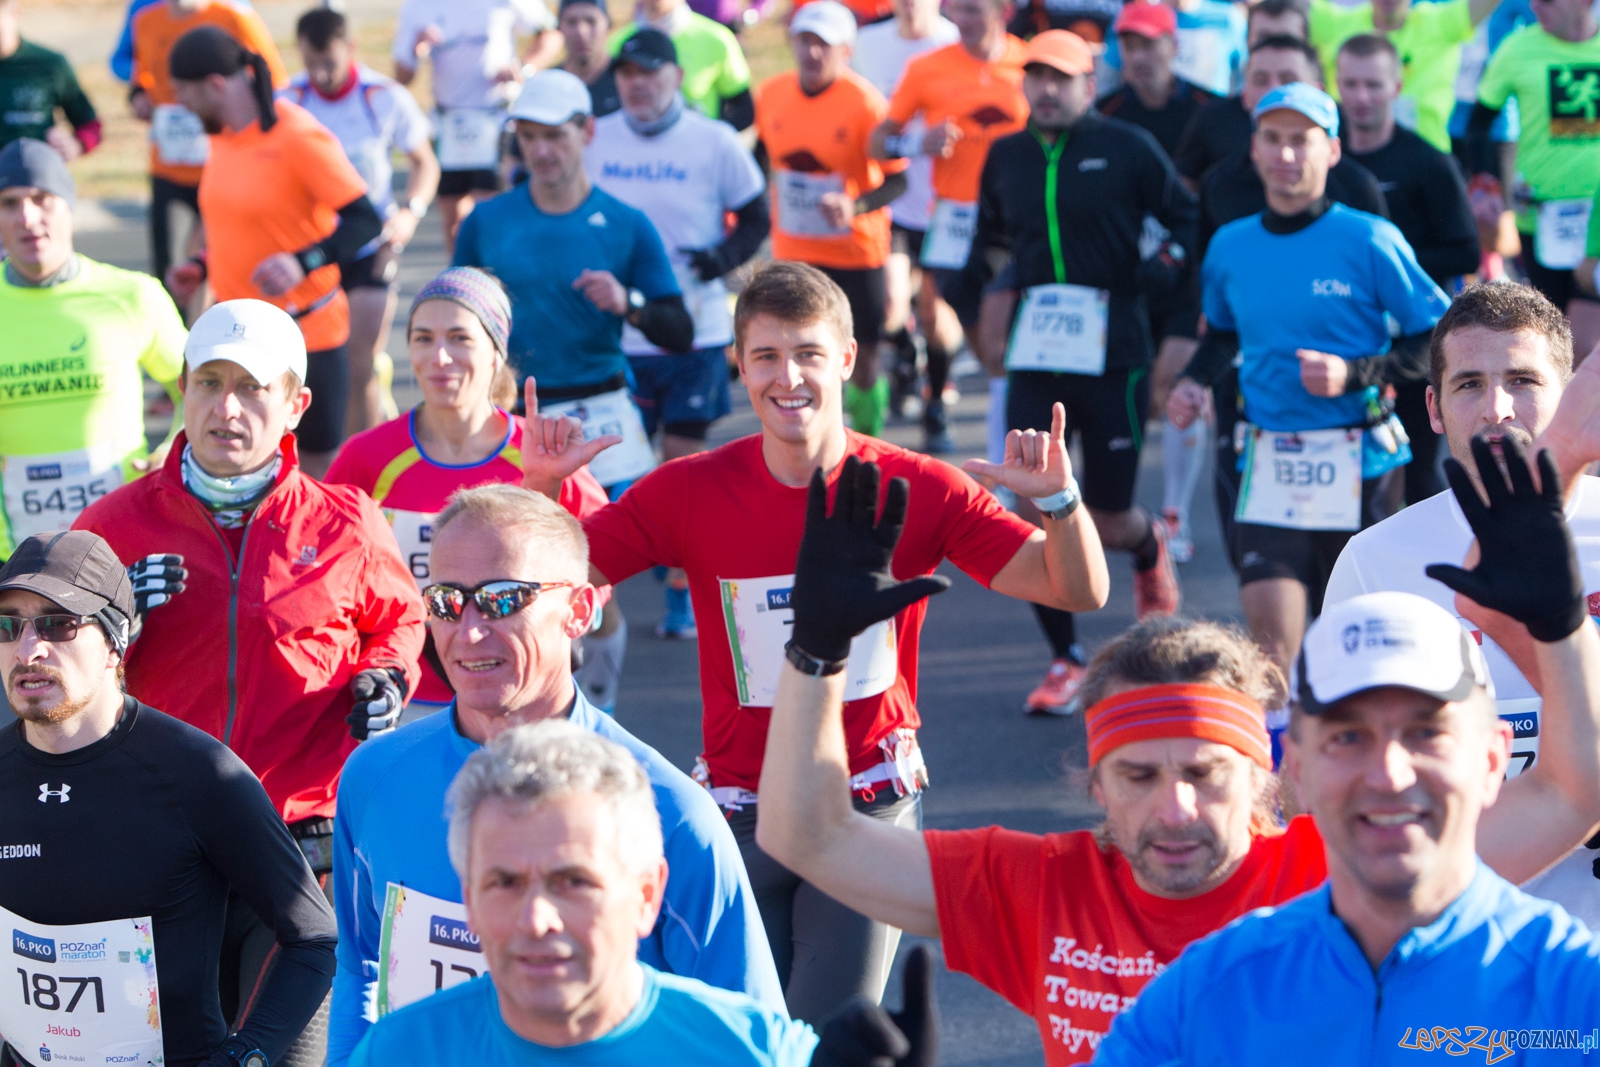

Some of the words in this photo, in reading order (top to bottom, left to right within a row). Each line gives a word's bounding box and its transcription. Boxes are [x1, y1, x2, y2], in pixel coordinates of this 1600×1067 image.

[0, 374, 104, 399] YZWANIE
[61, 950, 106, 960] maraton
[16, 967, 105, 1013] 1871
[46, 1023, 81, 1037] Jakub
[54, 1052, 68, 1061] Bank
[69, 1055, 86, 1063] Polski
